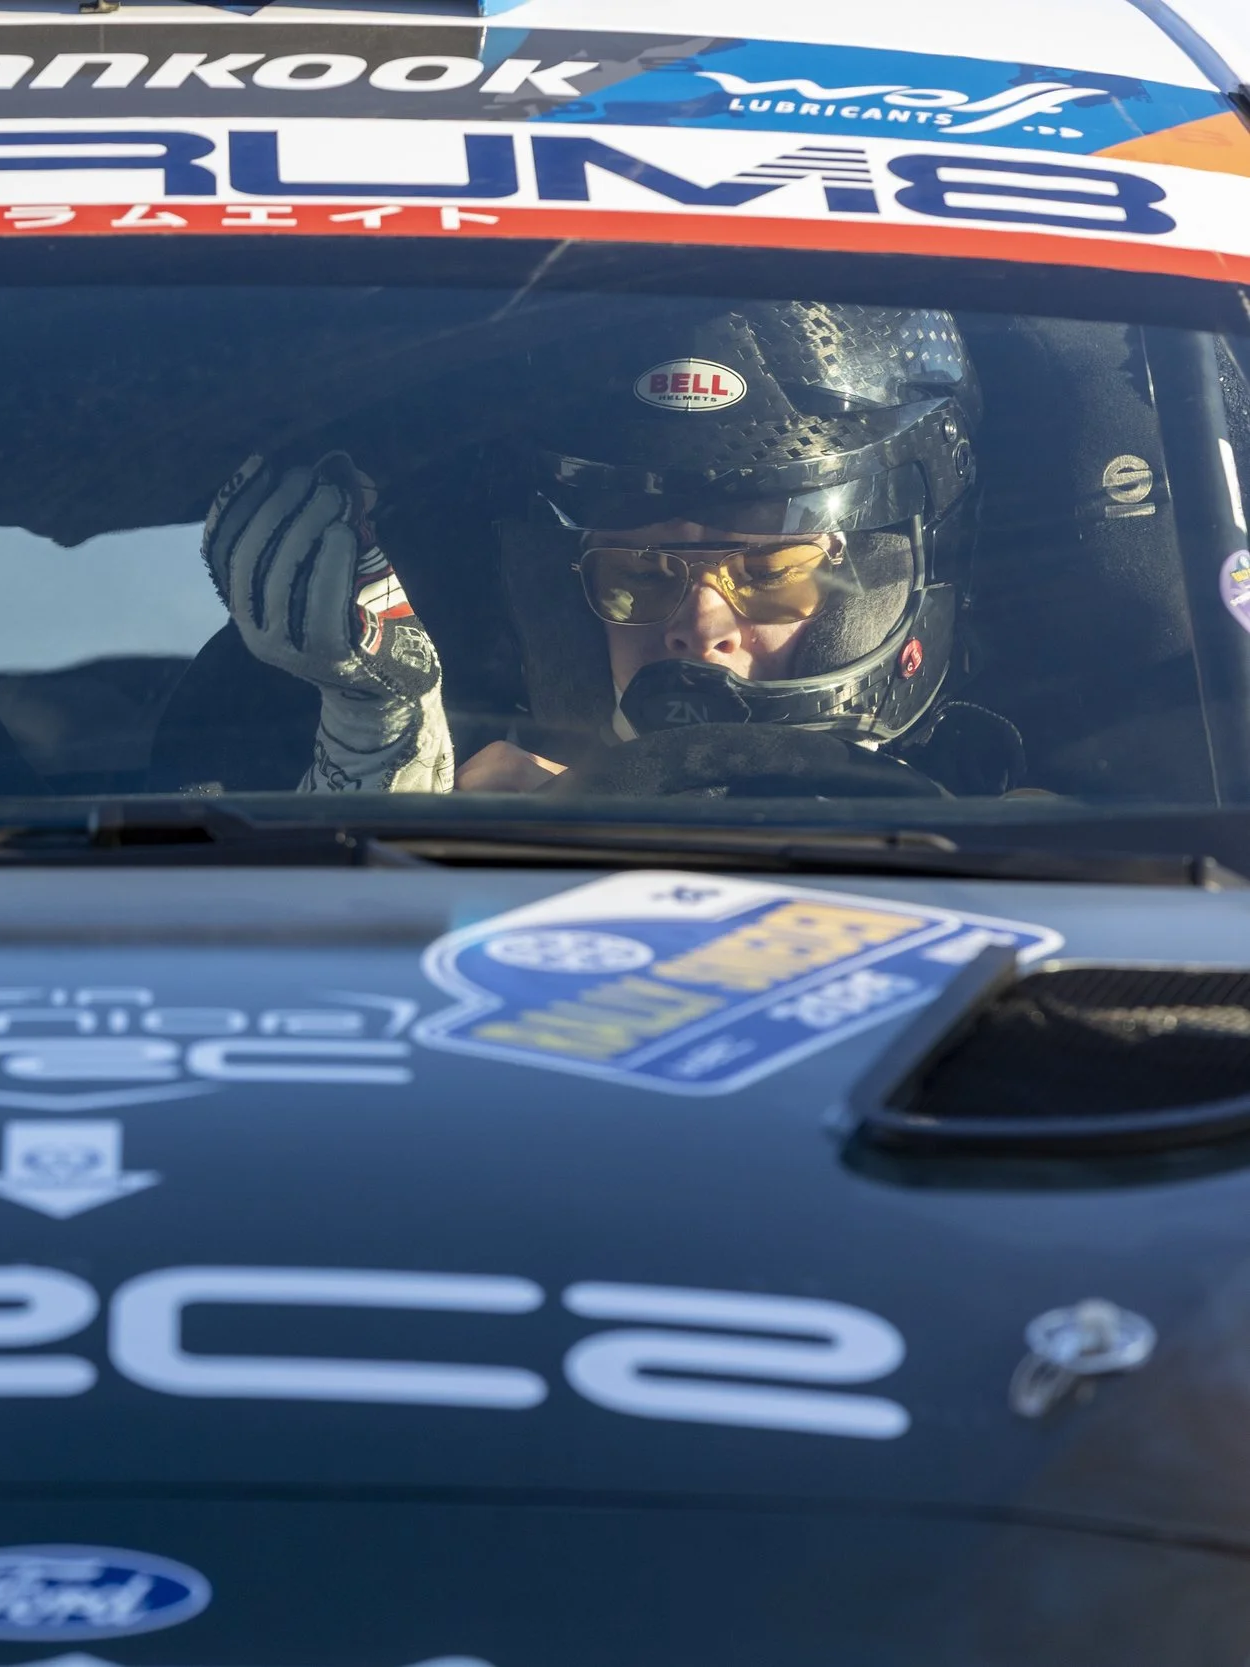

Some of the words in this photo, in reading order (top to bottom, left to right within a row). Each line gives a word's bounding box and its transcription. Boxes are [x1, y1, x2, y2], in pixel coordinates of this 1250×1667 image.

[729, 97, 954, 126] LUBRICANTS
[650, 373, 729, 395] BELL
[658, 395, 718, 403] HELMETS
